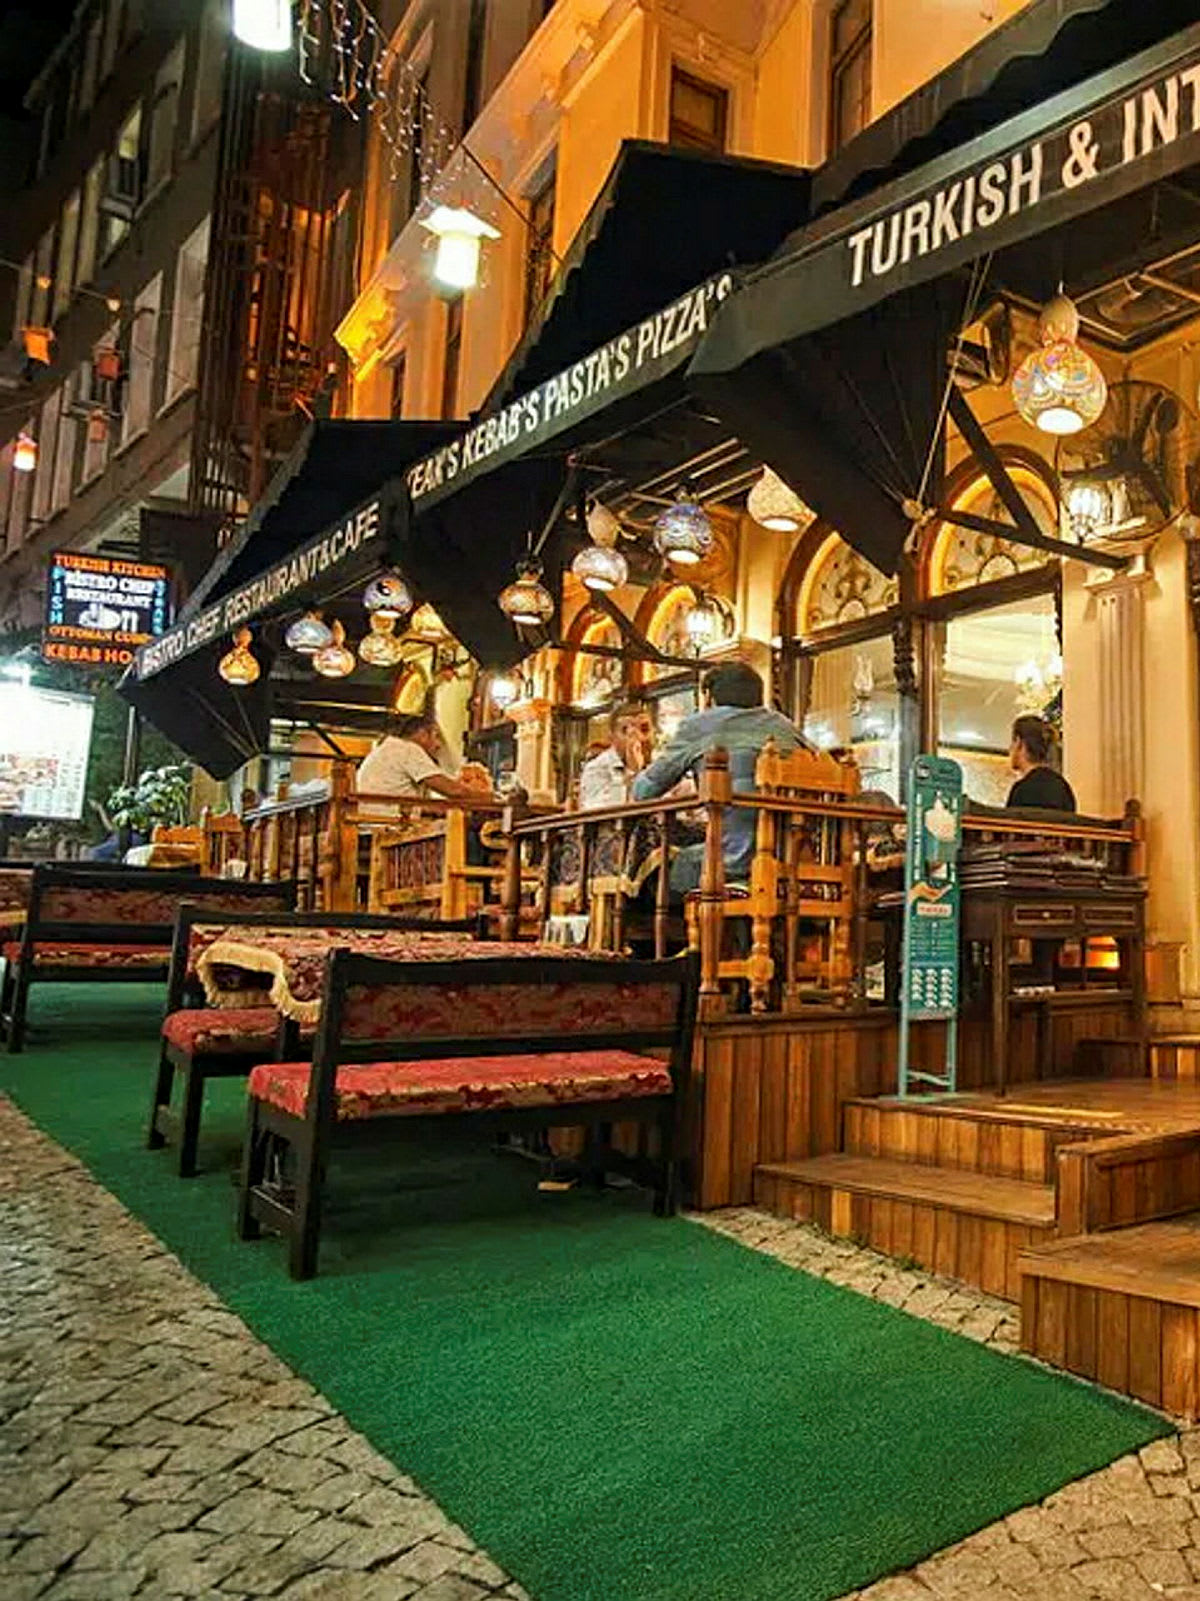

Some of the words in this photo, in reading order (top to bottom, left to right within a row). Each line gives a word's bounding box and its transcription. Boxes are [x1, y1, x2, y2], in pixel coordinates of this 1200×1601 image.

[847, 143, 1044, 287] TURKISH
[1061, 120, 1101, 189] &
[462, 390, 540, 470] KEBAB'S
[544, 335, 631, 422] PASTA'S
[45, 641, 102, 663] KEBAB
[103, 647, 134, 665] HO
